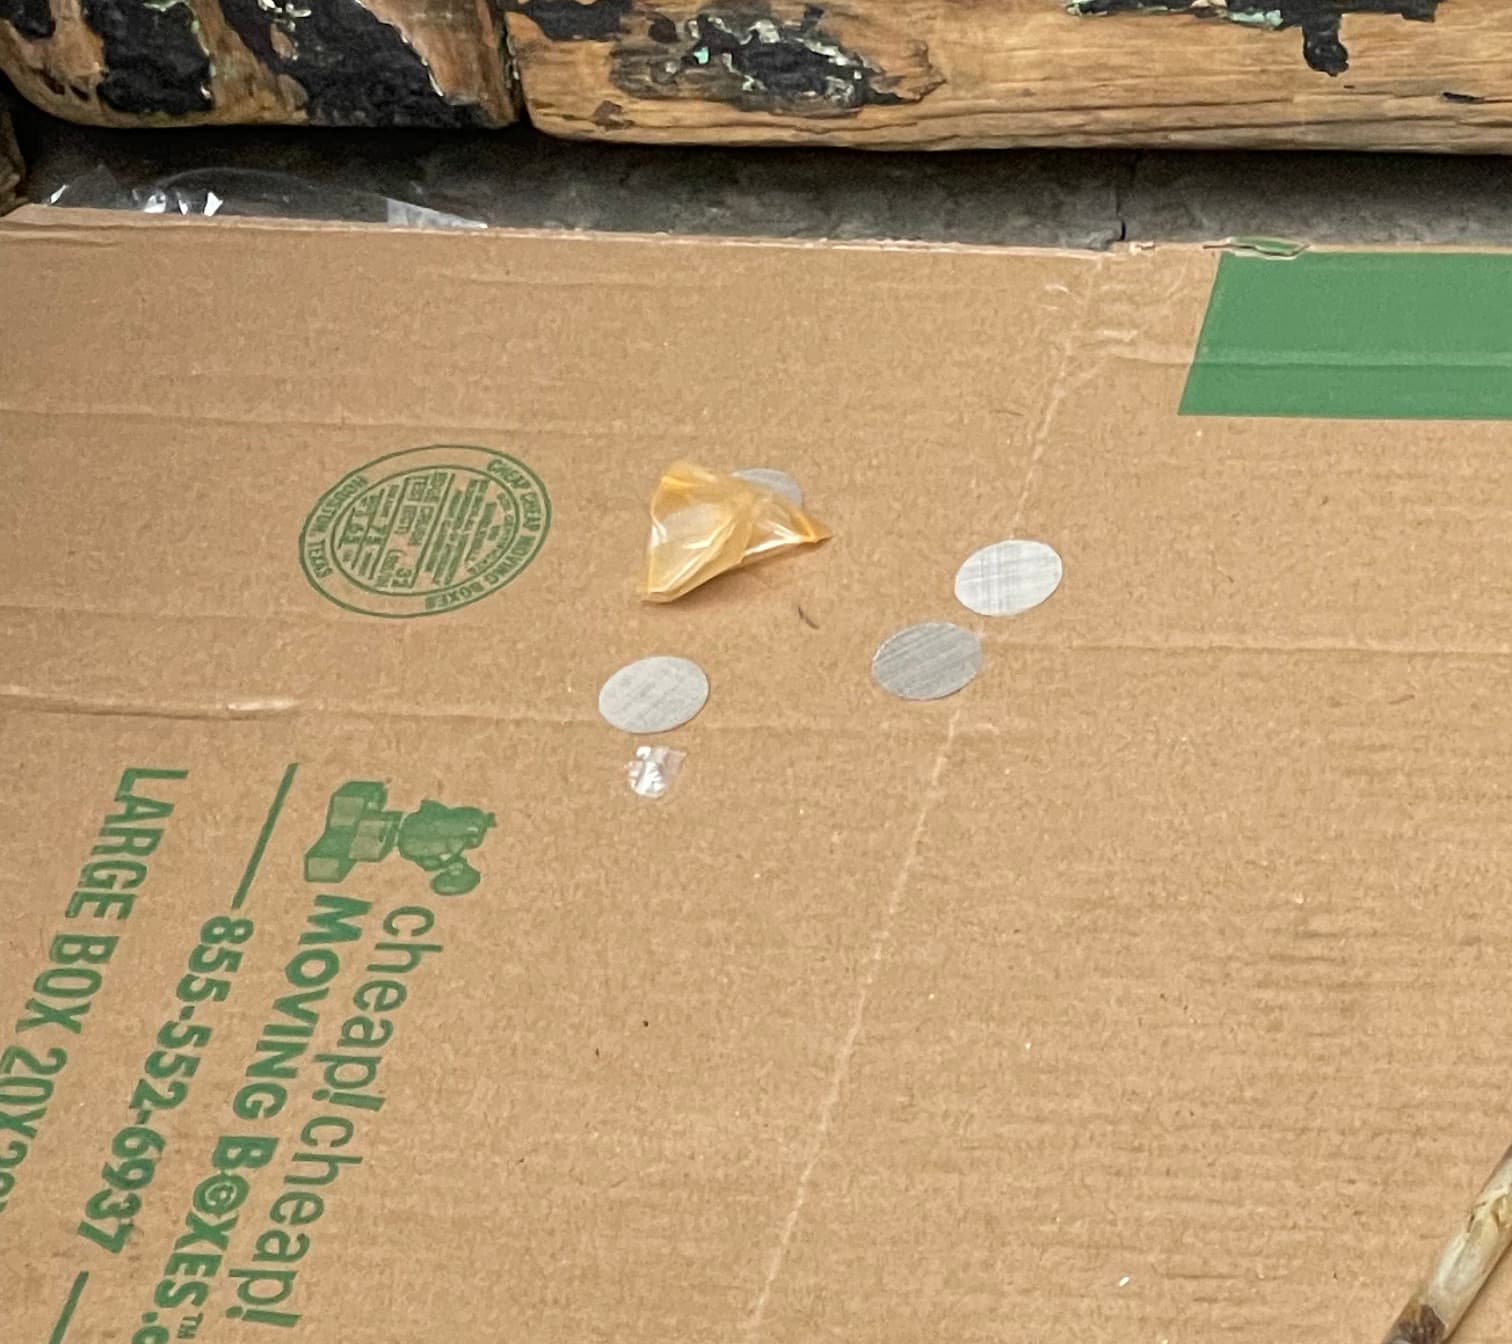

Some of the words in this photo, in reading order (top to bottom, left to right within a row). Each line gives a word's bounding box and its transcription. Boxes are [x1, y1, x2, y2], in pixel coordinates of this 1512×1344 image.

[65, 768, 188, 919] LARGE
[16, 936, 118, 1034] BOX
[232, 894, 372, 1120] MOVING
[78, 916, 254, 1253] 855-552-6937
